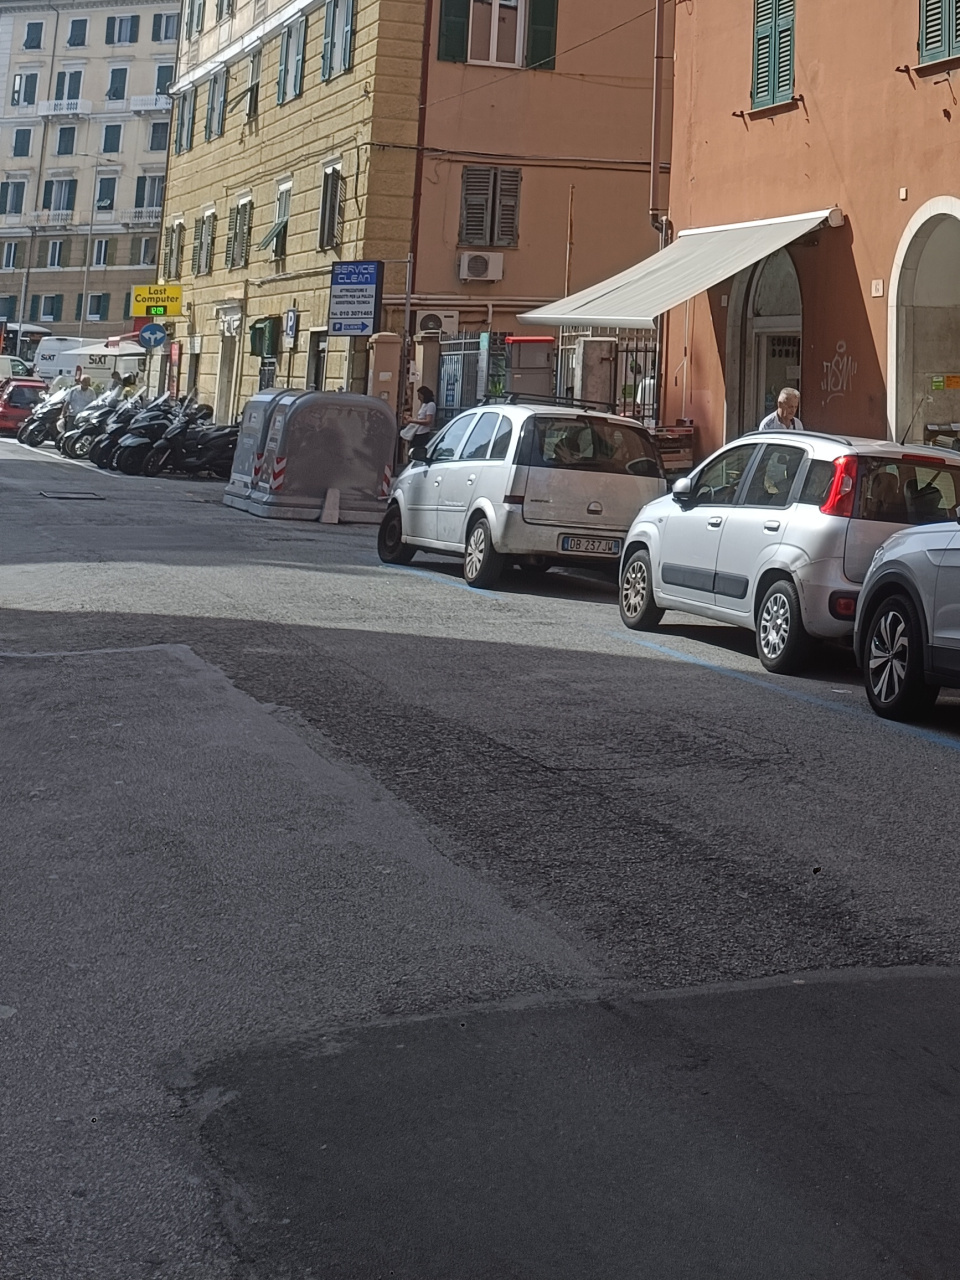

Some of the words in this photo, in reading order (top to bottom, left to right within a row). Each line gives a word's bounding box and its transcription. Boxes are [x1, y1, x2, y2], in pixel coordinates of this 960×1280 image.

[334, 265, 375, 274] SERVICE
[338, 274, 370, 282] CLEAN
[148, 286, 167, 295] Last
[135, 294, 179, 304] Computer
[570, 538, 581, 549] DB
